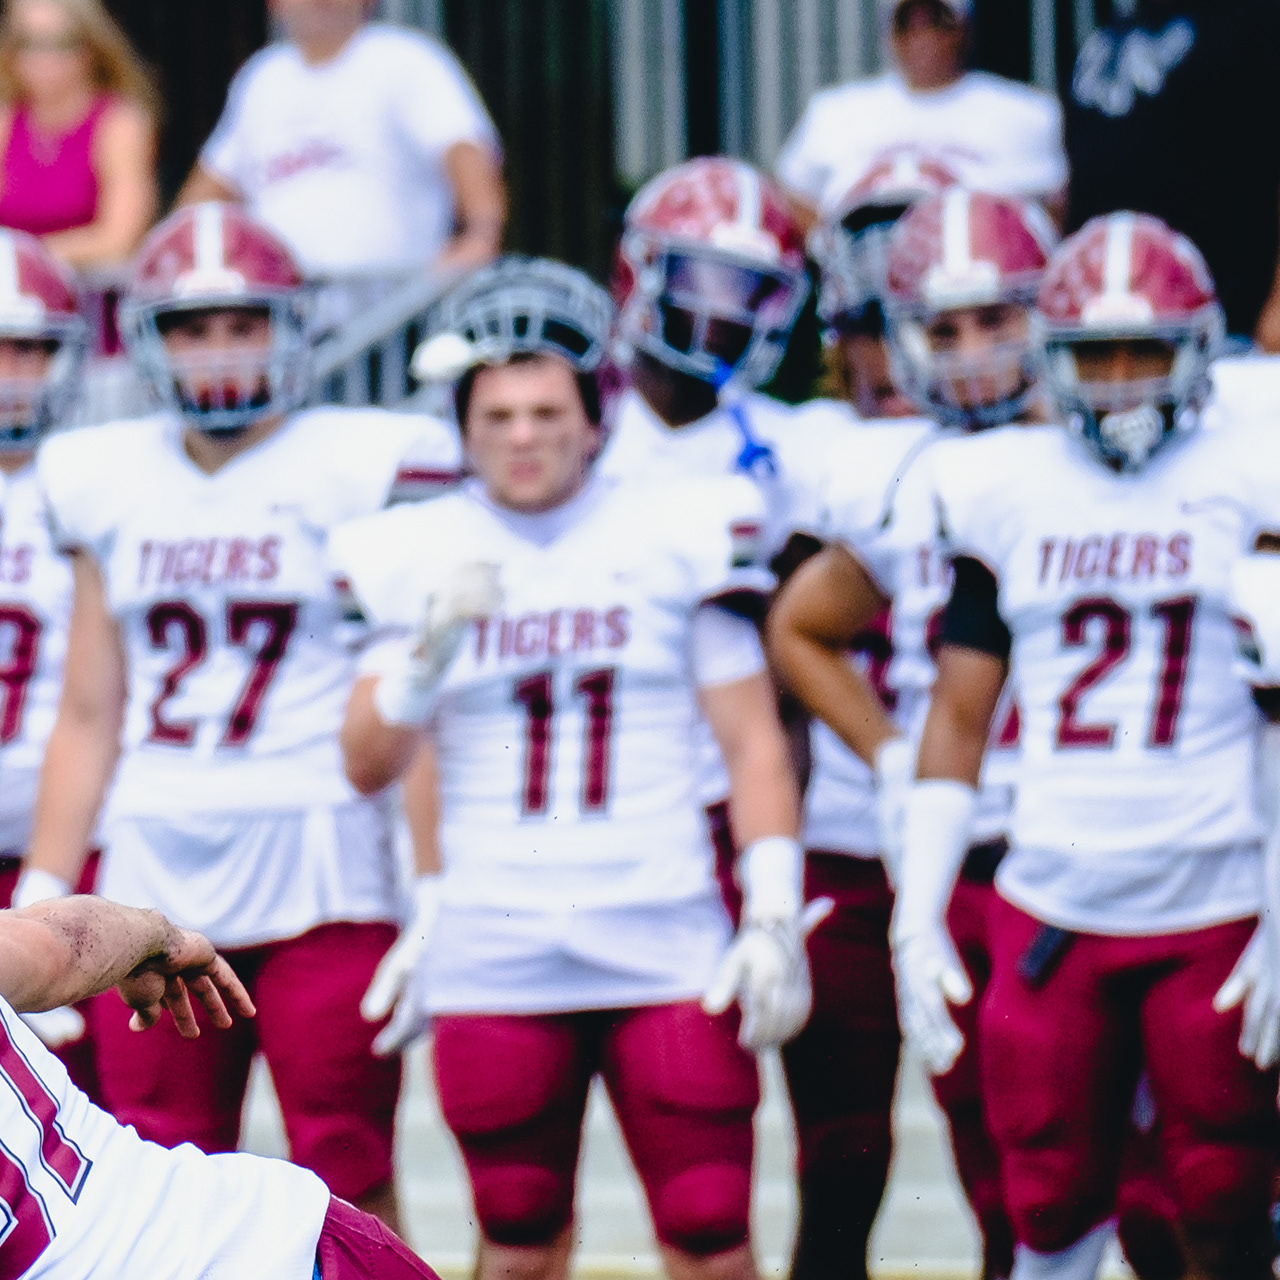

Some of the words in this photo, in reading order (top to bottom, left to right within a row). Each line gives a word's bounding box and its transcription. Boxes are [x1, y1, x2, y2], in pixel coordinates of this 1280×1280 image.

[140, 536, 280, 586] TIGERS
[1039, 532, 1193, 584] TIGERS
[144, 600, 300, 748] 27
[474, 606, 630, 662] TIGERS
[1053, 594, 1200, 748] 21
[512, 670, 616, 815] 11
